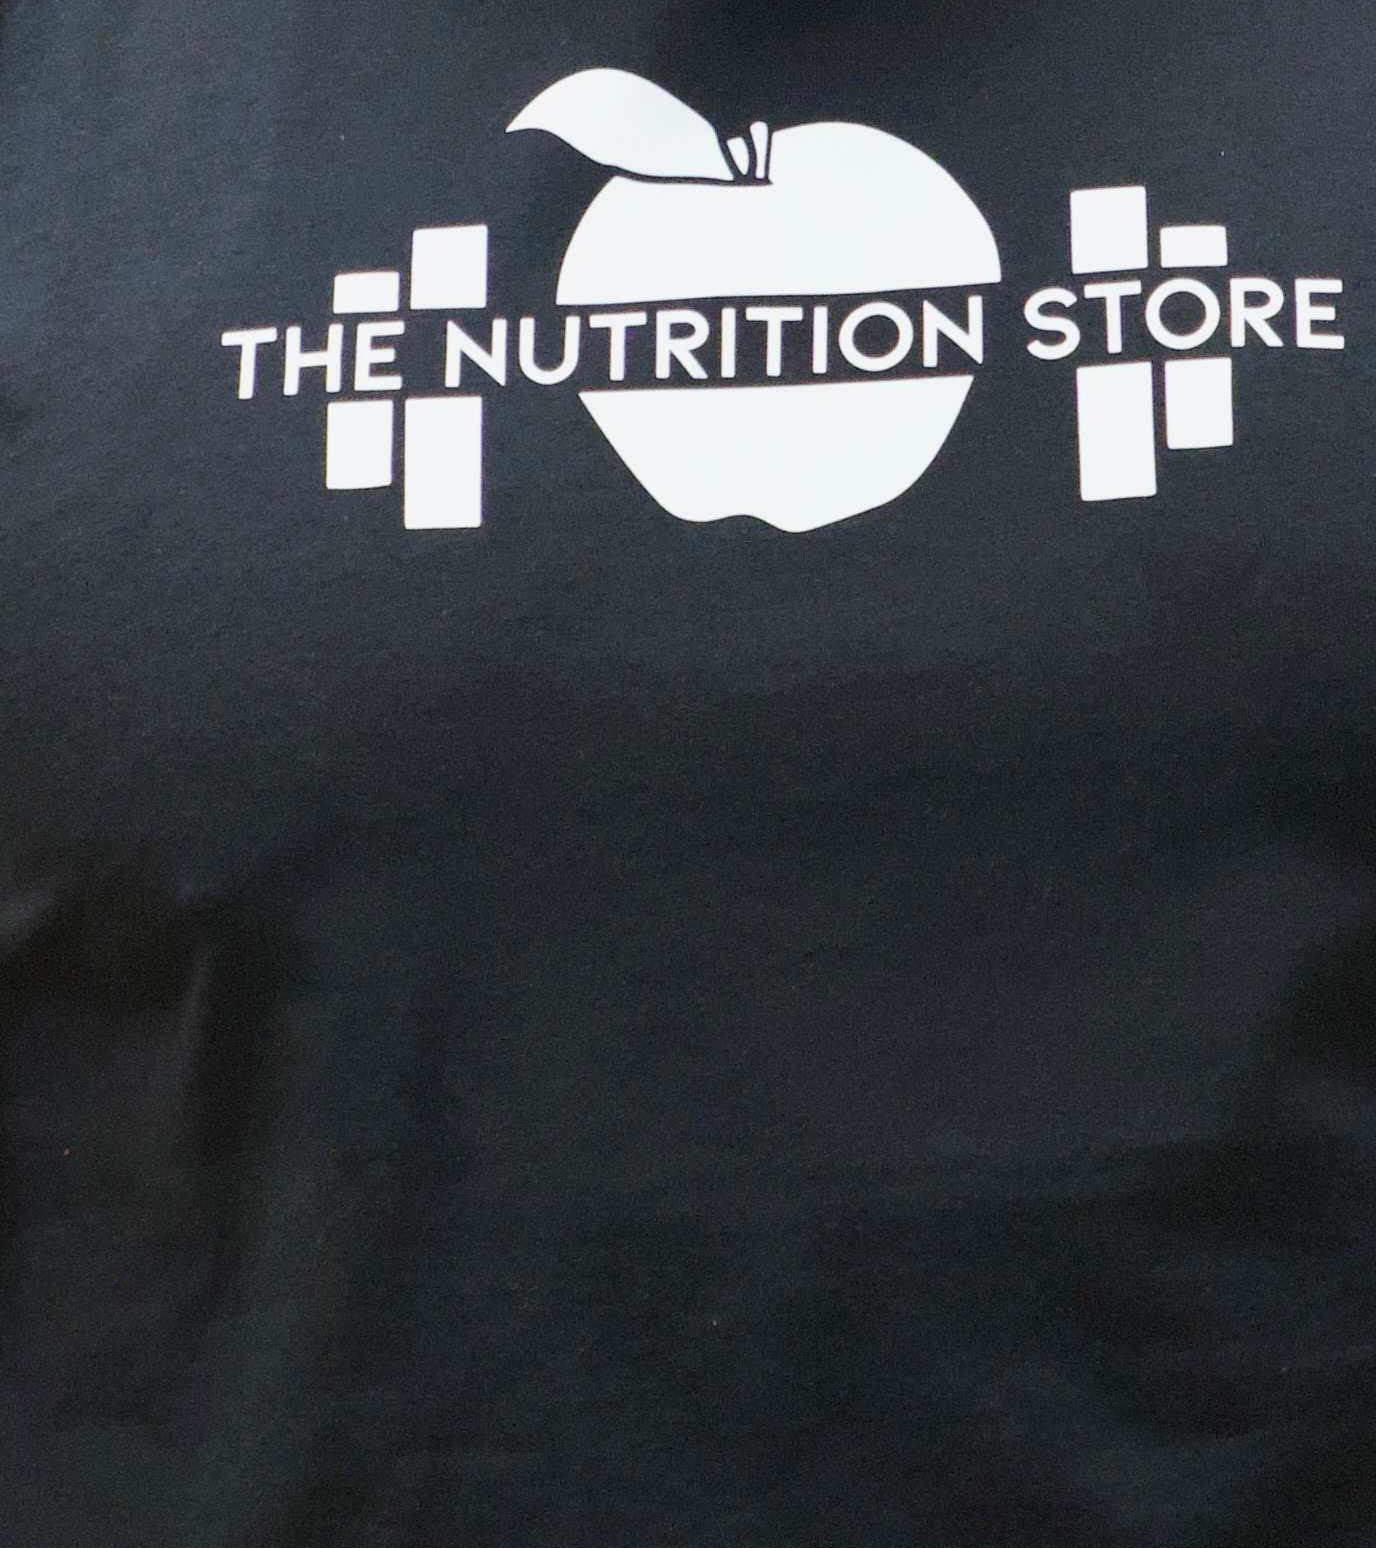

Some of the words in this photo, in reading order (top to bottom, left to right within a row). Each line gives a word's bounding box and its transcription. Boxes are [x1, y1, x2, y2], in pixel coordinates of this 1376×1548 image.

[222, 320, 404, 400] THE
[444, 296, 983, 388] NUTRITION
[1024, 277, 1345, 361] STORE
